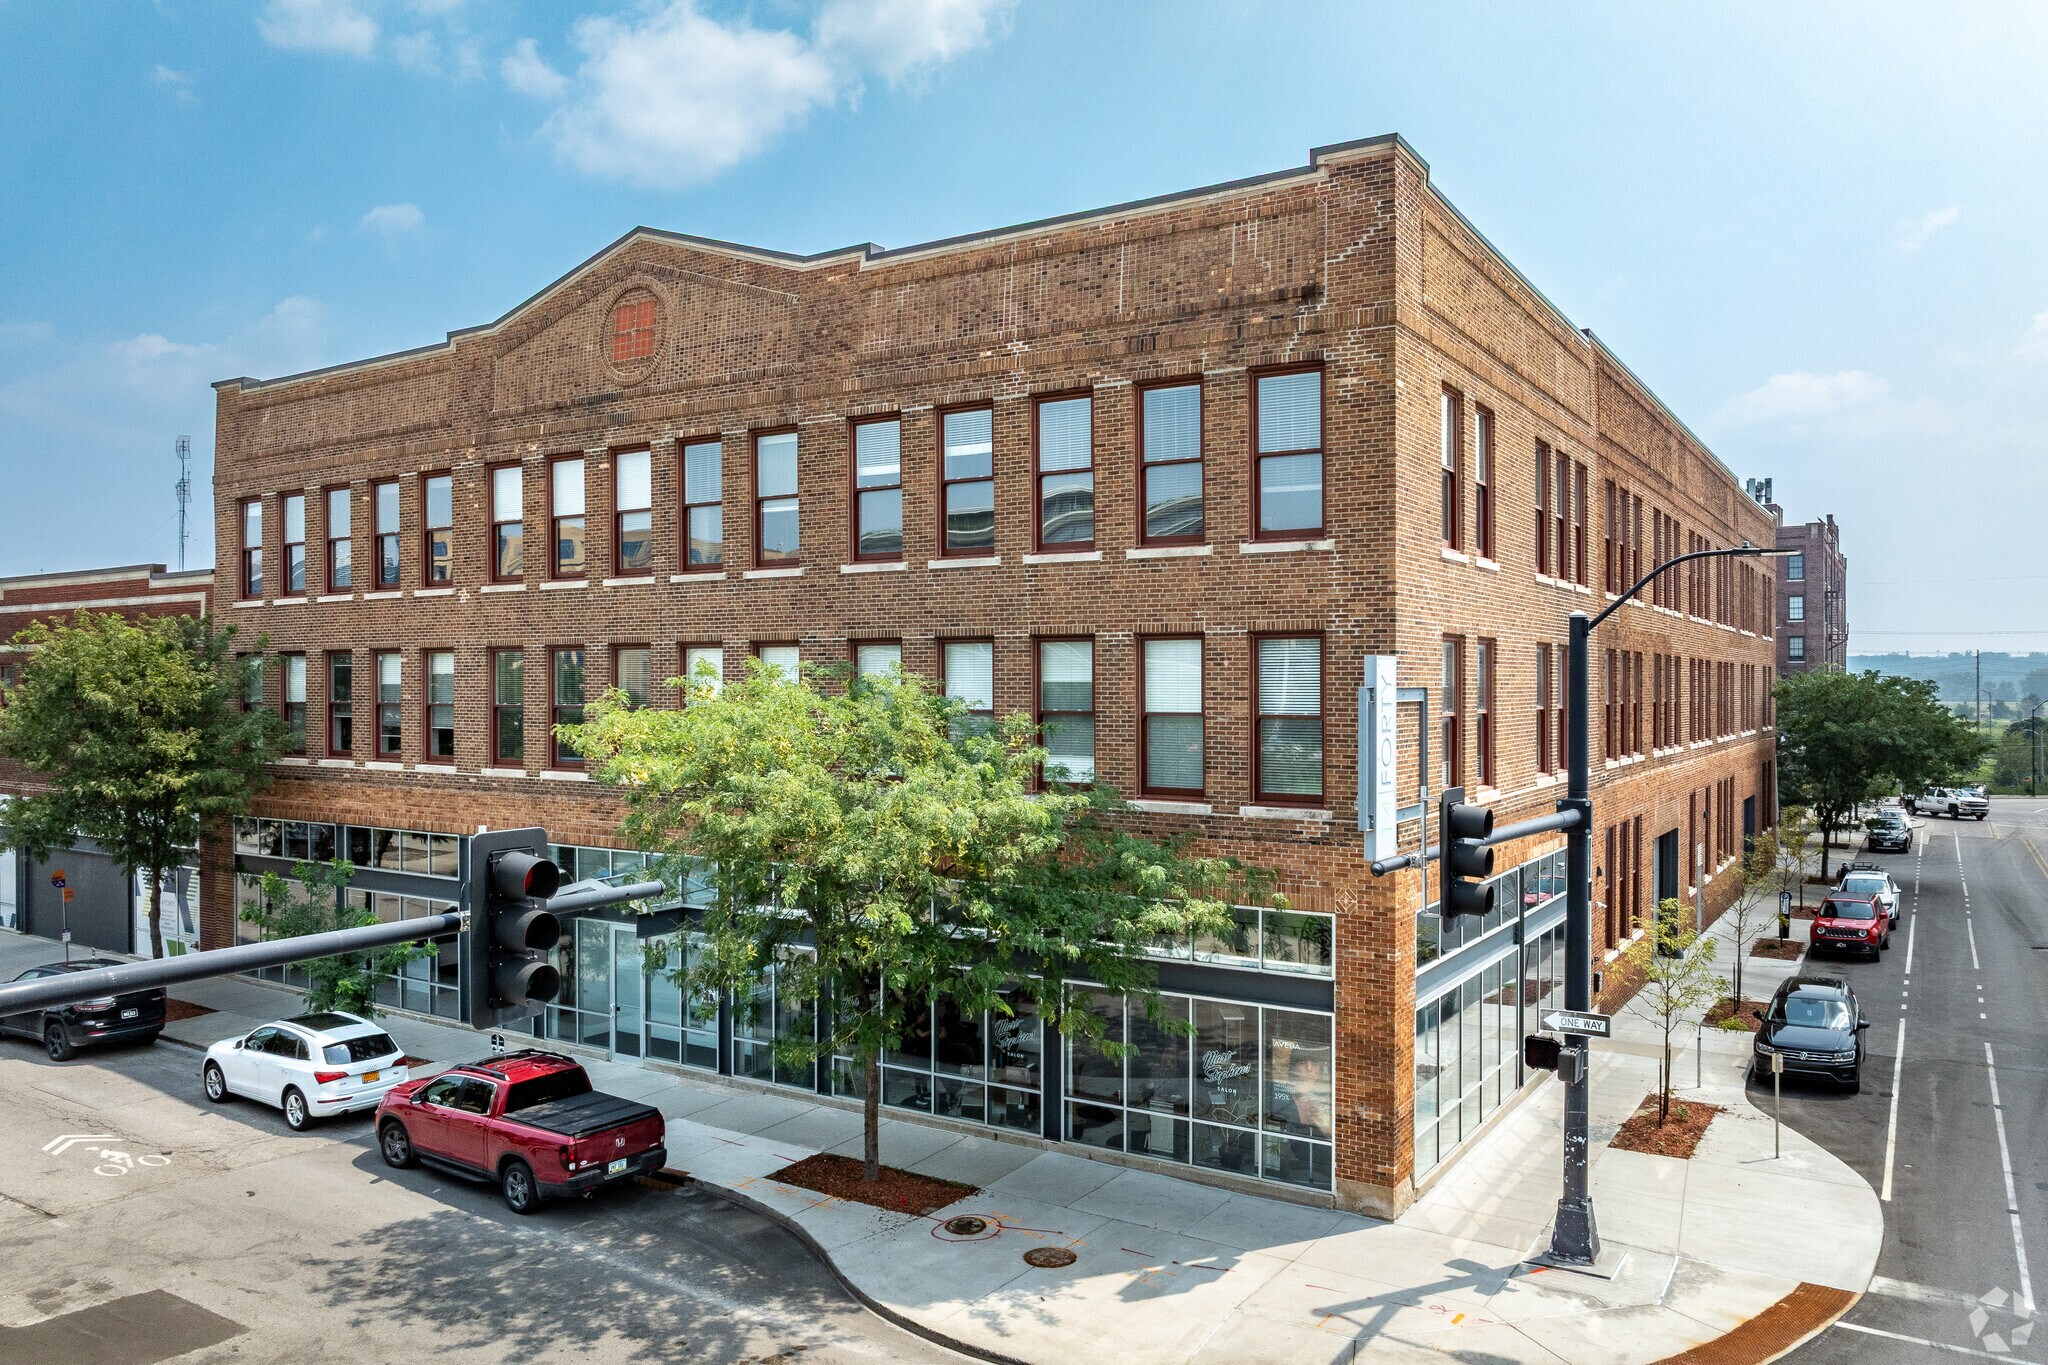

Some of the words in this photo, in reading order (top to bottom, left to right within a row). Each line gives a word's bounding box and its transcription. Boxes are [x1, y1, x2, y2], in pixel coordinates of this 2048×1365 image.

[1381, 675, 1392, 786] FORTY
[1560, 1017, 1580, 1028] ONE
[1583, 1020, 1603, 1030] WAY
[1273, 1041, 1301, 1050] AVEDA
[1007, 1051, 1024, 1059] SALON
[1217, 1086, 1237, 1094] SALON
